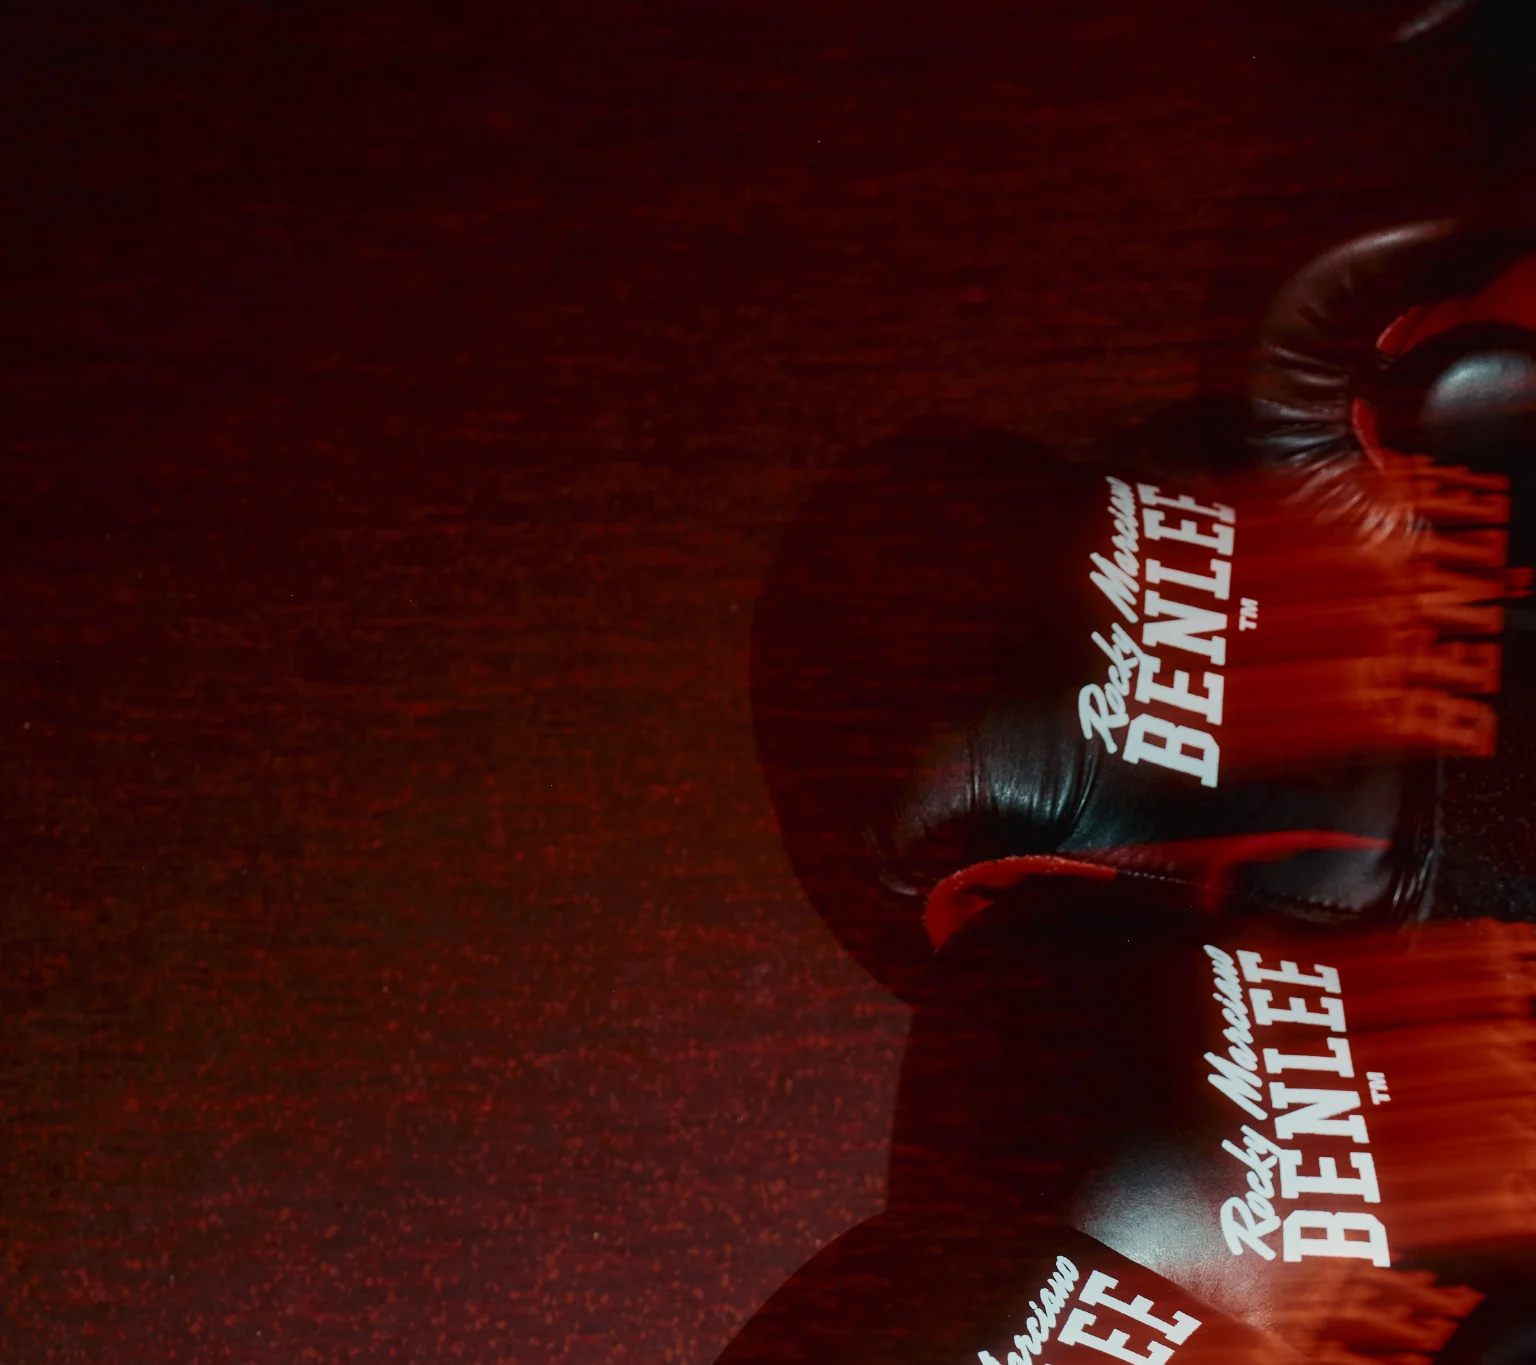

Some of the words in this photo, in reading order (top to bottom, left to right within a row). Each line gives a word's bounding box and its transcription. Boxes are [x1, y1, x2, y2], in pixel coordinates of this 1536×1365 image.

[1077, 622, 1146, 755] Rocky
[1121, 482, 1236, 788] BENLEE
[1203, 944, 1269, 1121] Marciano
[1236, 949, 1391, 1268] BENLEE
[1219, 1124, 1281, 1261] Rocky
